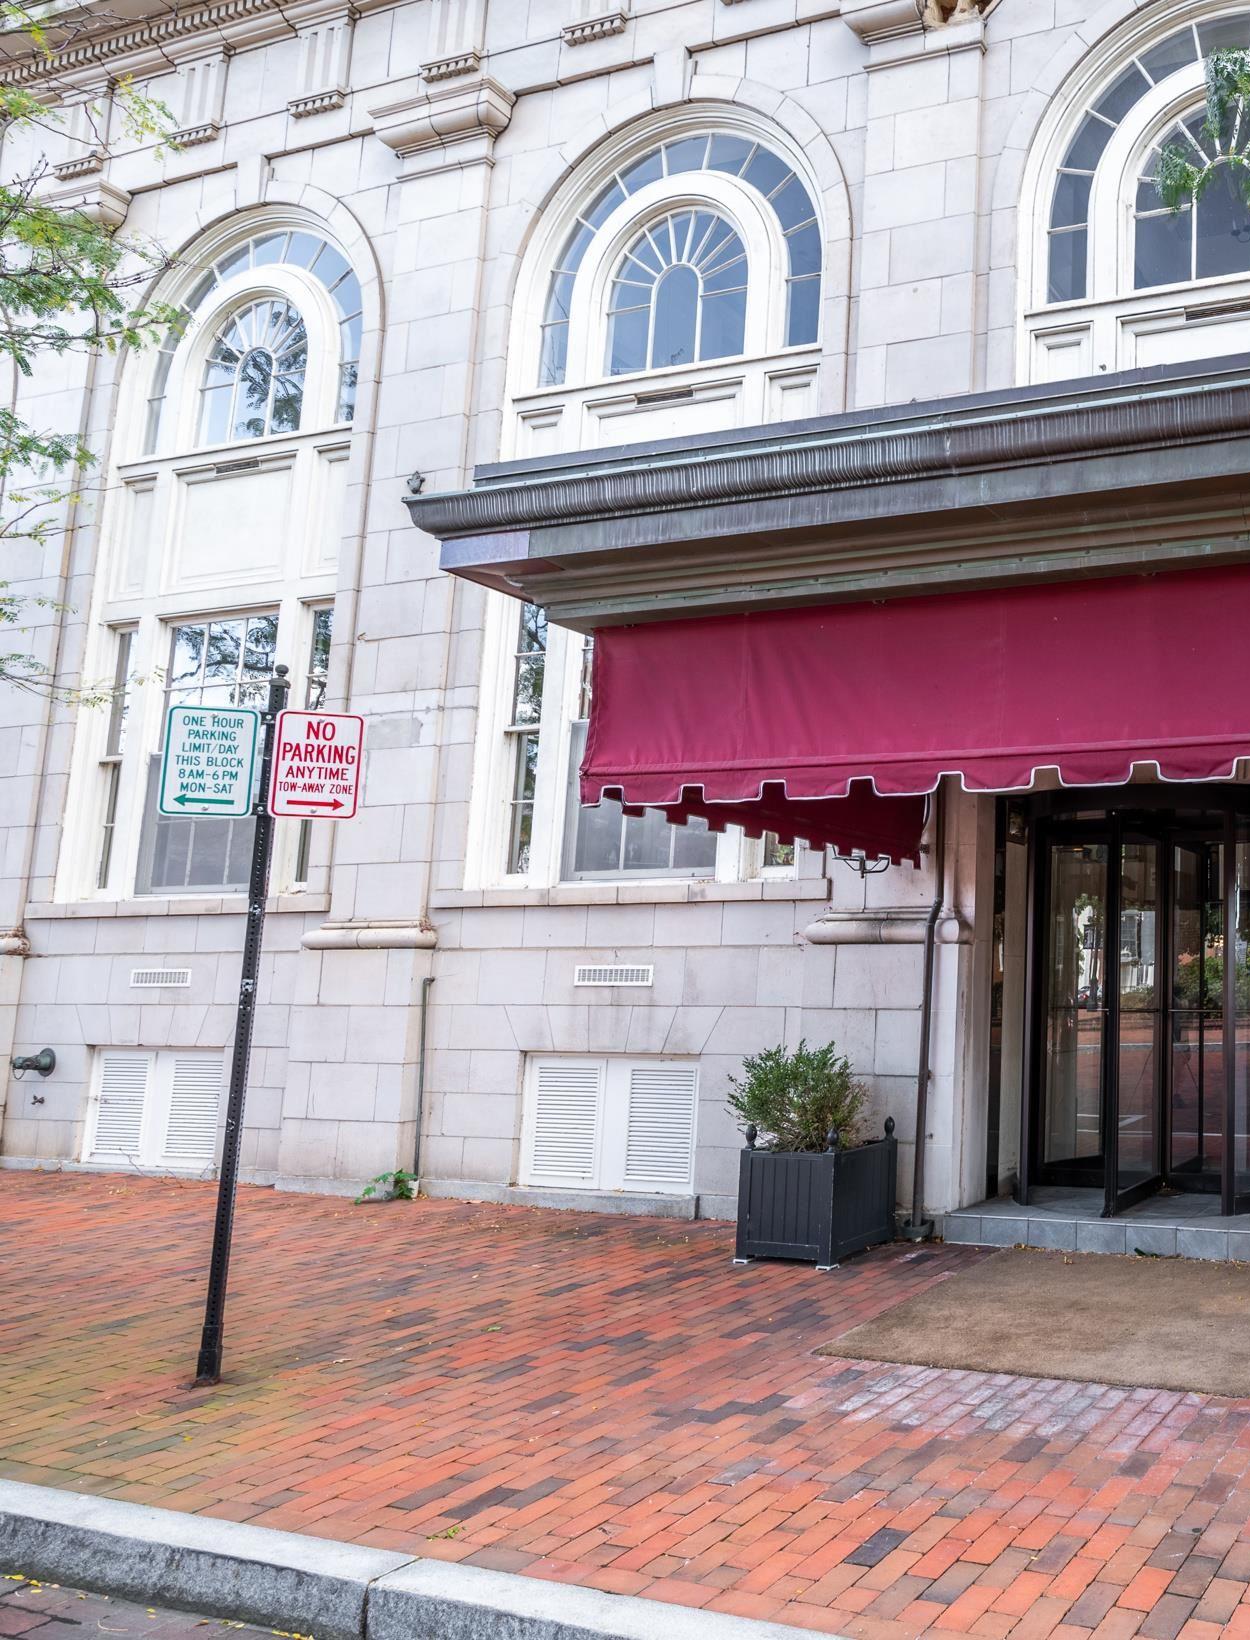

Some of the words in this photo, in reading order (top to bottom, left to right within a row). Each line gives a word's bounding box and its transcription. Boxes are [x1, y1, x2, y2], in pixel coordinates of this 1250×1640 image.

[183, 715, 206, 727] ONE
[212, 716, 244, 729] HOUR
[187, 729, 237, 741] PARKING
[305, 721, 336, 741] NO
[181, 742, 240, 755] LIMIT/DAY
[281, 742, 356, 765] PARKING
[175, 755, 201, 766] THIS
[206, 756, 244, 768] BLOCK
[285, 765, 349, 781] ANYTIME
[179, 781, 234, 794] MON-SAT
[278, 781, 326, 794] TOW-AWAY
[329, 782, 354, 795] ZONE
